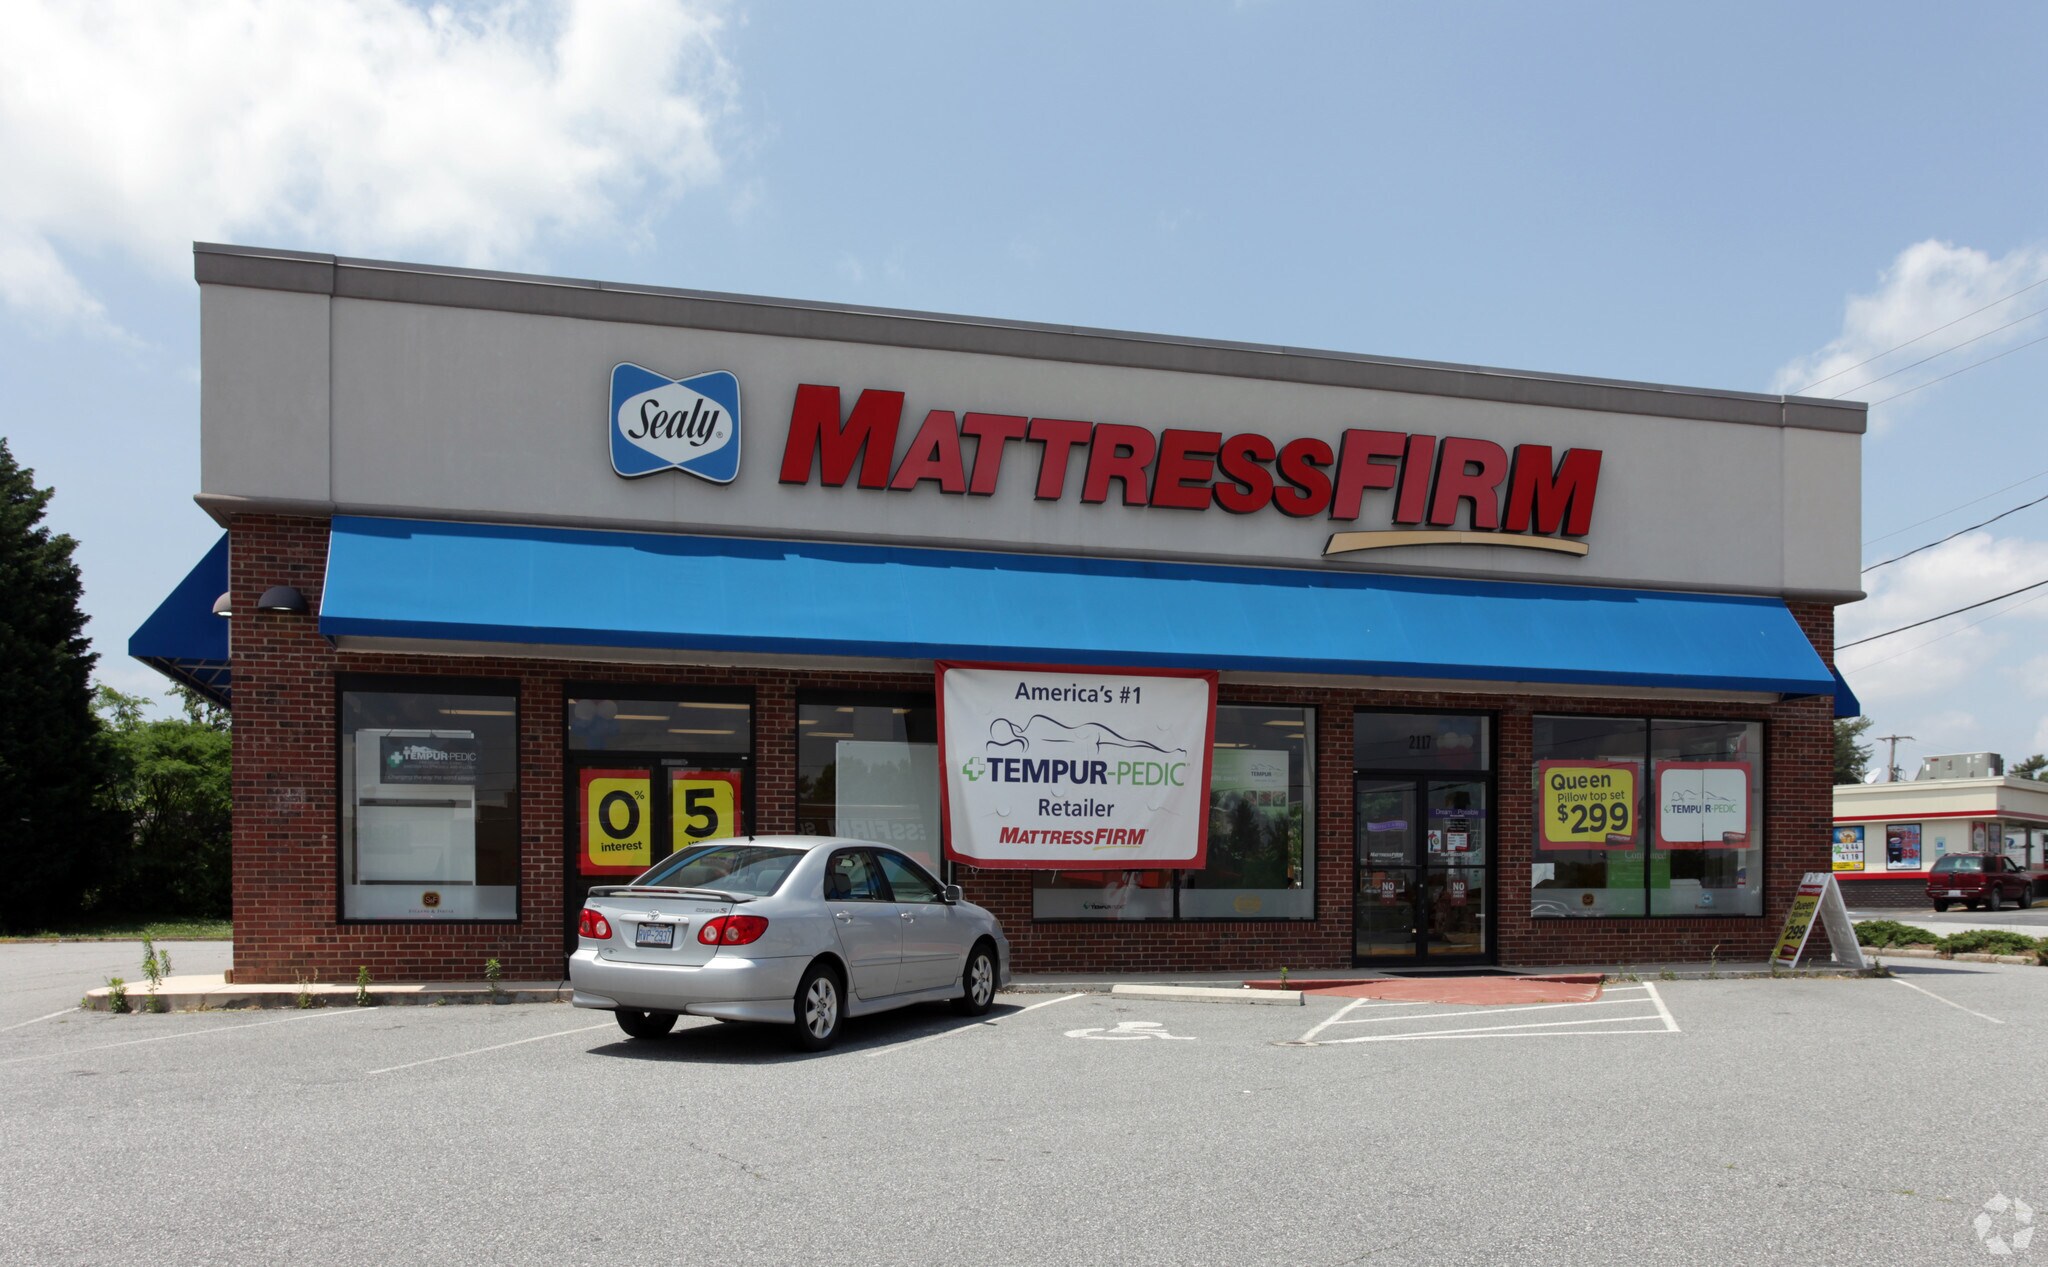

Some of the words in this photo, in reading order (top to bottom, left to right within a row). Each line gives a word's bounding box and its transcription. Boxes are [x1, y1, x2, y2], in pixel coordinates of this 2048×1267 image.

[628, 398, 720, 447] Sealy
[779, 383, 1603, 536] MATTRESSFIRM
[1015, 682, 1113, 704] America's
[1119, 686, 1141, 704] #1
[1409, 735, 1431, 750] 2117
[987, 757, 1186, 787] TEMPUR-PEDIC
[1551, 773, 1611, 791] Queen
[1557, 792, 1588, 803] Pillow
[1590, 792, 1607, 803] top
[1610, 790, 1625, 800] set
[684, 788, 719, 838] 5
[1038, 798, 1114, 817] Retailer
[1557, 802, 1629, 834] $299
[601, 840, 643, 852] interest
[1382, 882, 1395, 891] NO
[1452, 882, 1465, 891] NO
